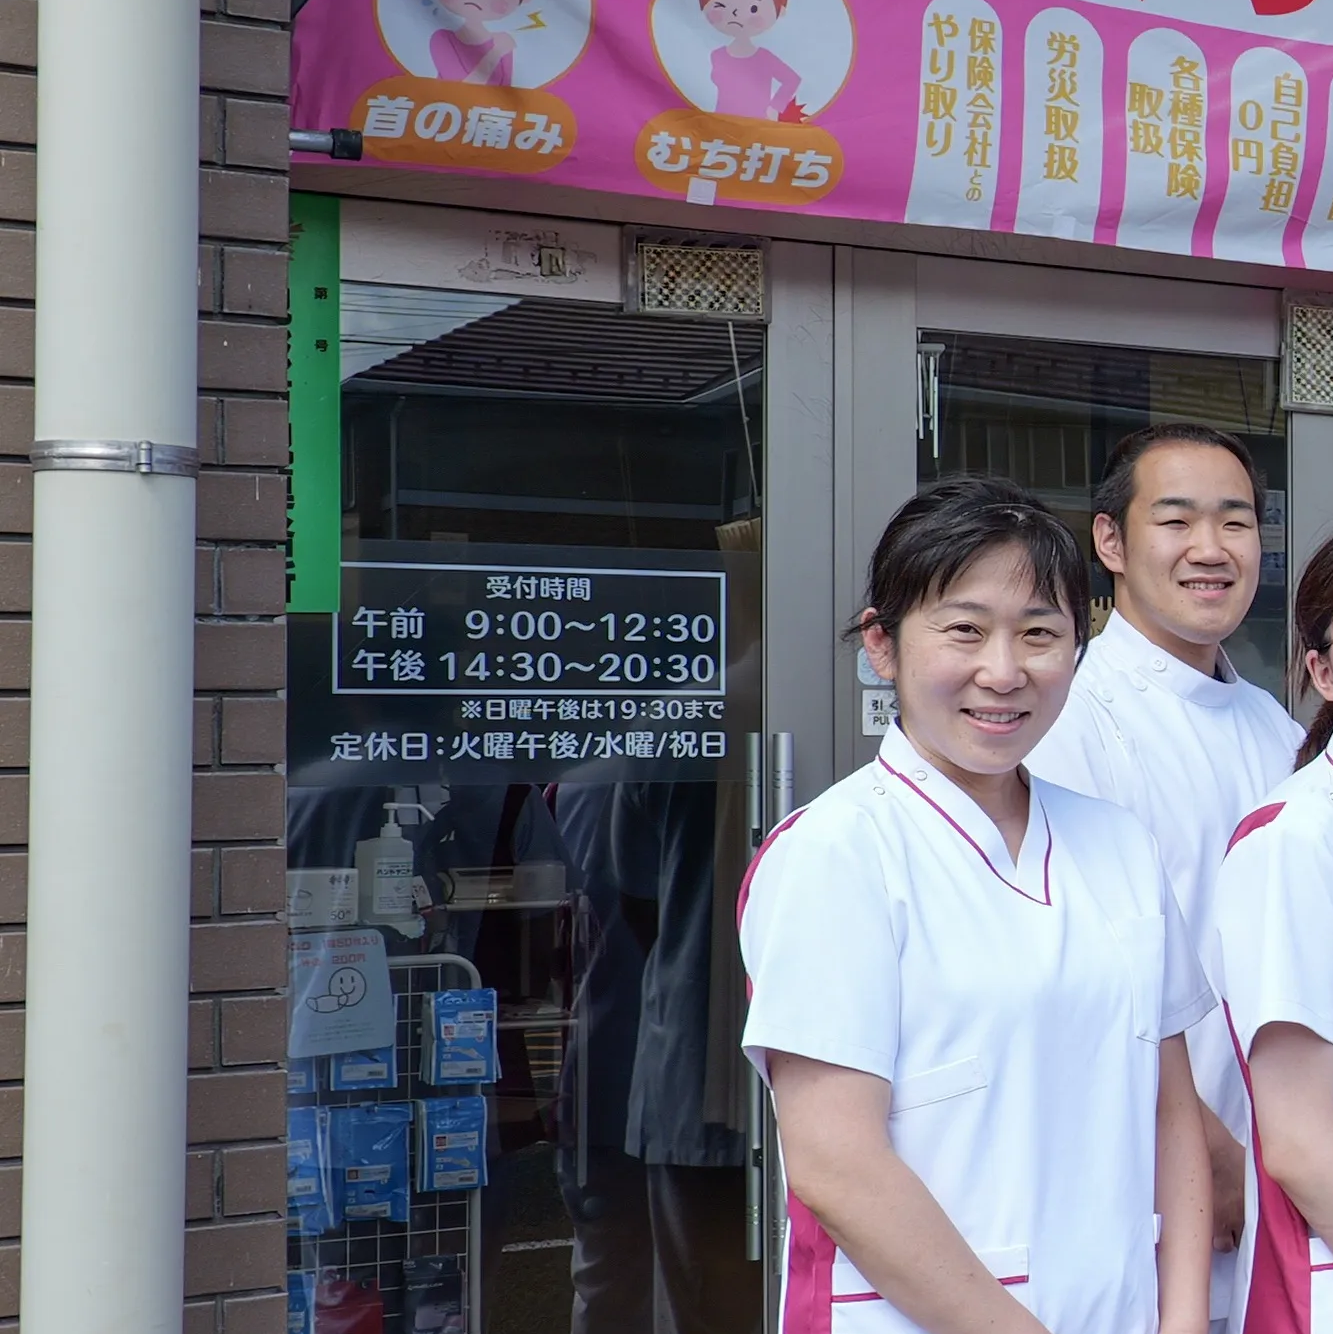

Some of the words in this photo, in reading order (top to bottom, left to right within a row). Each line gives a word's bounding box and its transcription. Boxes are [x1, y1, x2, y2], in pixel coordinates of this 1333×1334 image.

[922, 12, 961, 157] やり取り
[964, 17, 997, 202] 保険会社との
[1043, 31, 1082, 185] 労災取扱
[361, 93, 565, 155] 首の痛み
[1127, 81, 1166, 158] 取扱
[1166, 55, 1204, 201] 各種保険
[1260, 72, 1303, 215] 自己負担
[646, 131, 833, 188] むち打ち
[485, 575, 592, 603] 受付時間
[351, 607, 426, 641] 午前
[351, 649, 426, 684] 午後
[459, 698, 726, 723] ※日曜午後は19:30まで
[329, 731, 728, 763] 定休日:火曜午後/水曜/祝日
